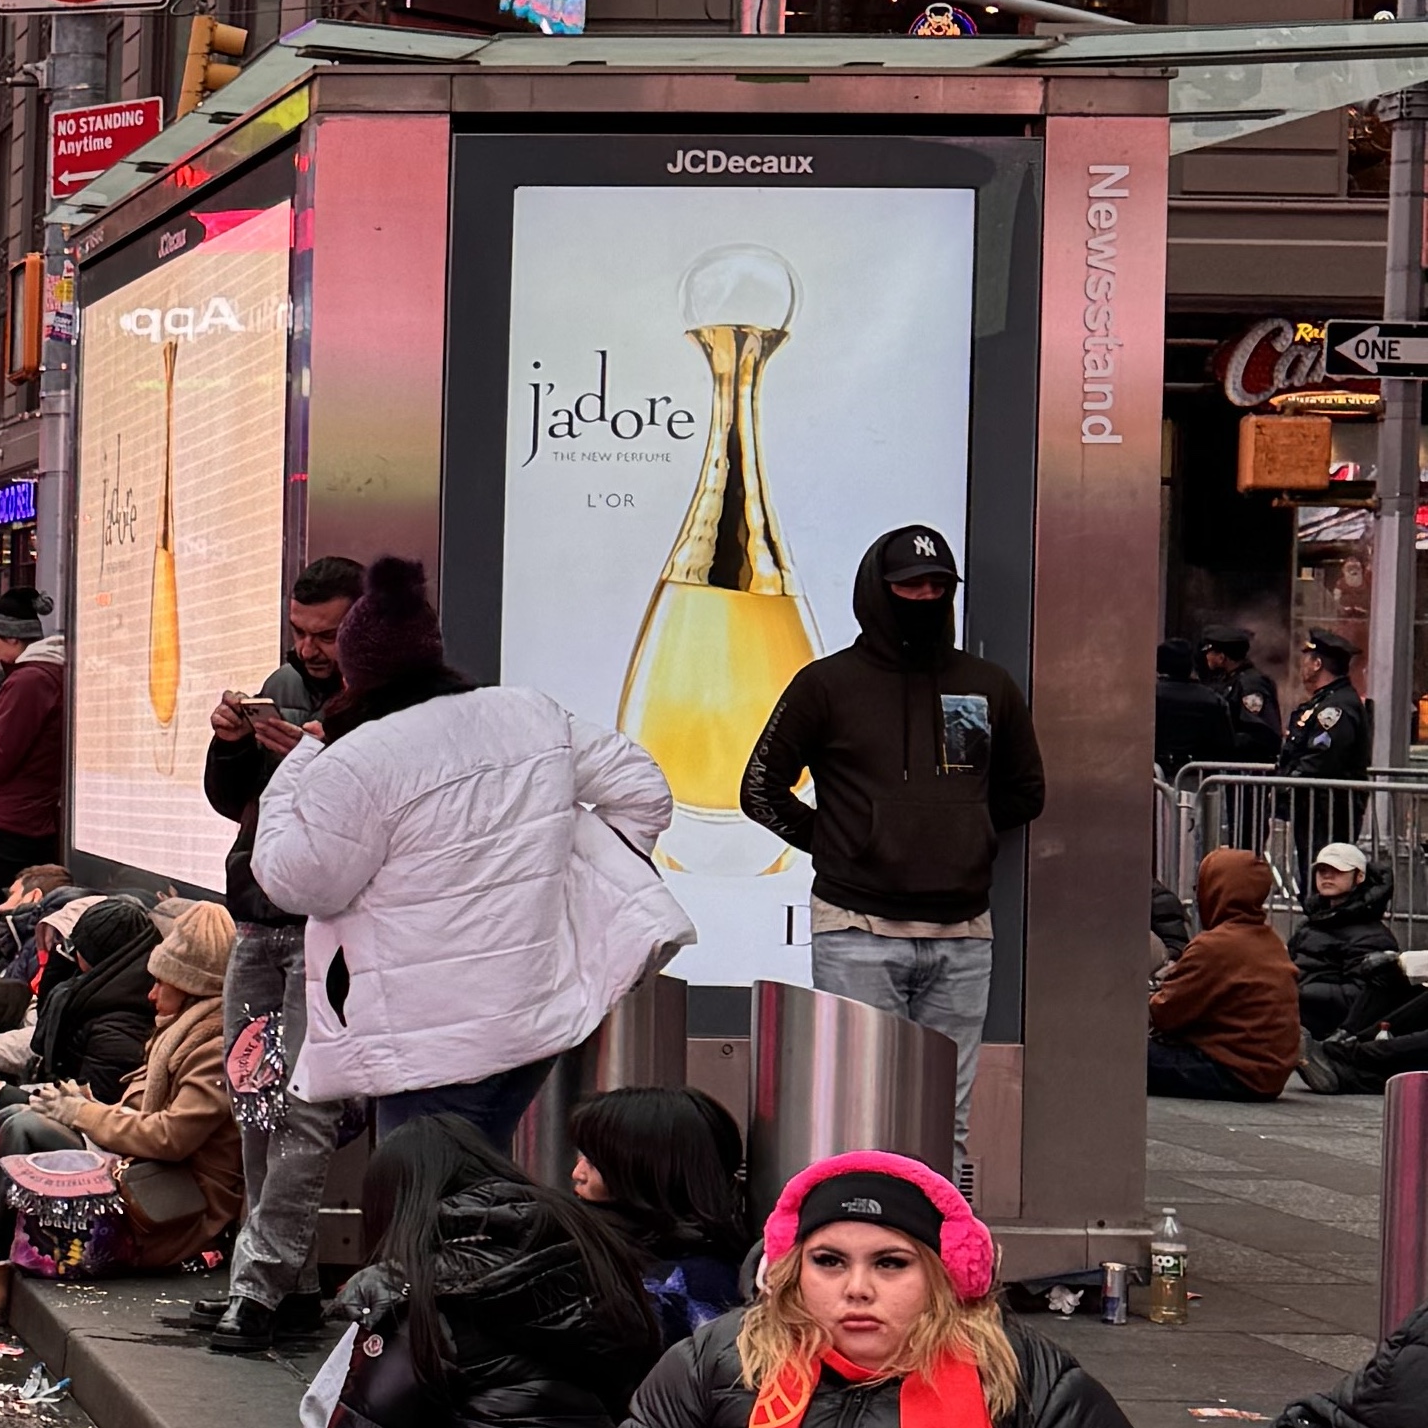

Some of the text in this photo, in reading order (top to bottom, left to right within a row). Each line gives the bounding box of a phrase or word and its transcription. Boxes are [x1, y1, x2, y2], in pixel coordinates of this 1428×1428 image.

[56, 109, 145, 136] NO STANDING
[57, 133, 113, 157] Anytime
[666, 148, 814, 175] JCDecaux
[1080, 163, 1131, 446] Newsstand
[1354, 339, 1402, 361] ONE
[521, 349, 695, 468] j'adore
[553, 451, 672, 463] THE NEW PERFUME
[587, 493, 636, 508] L'OR
